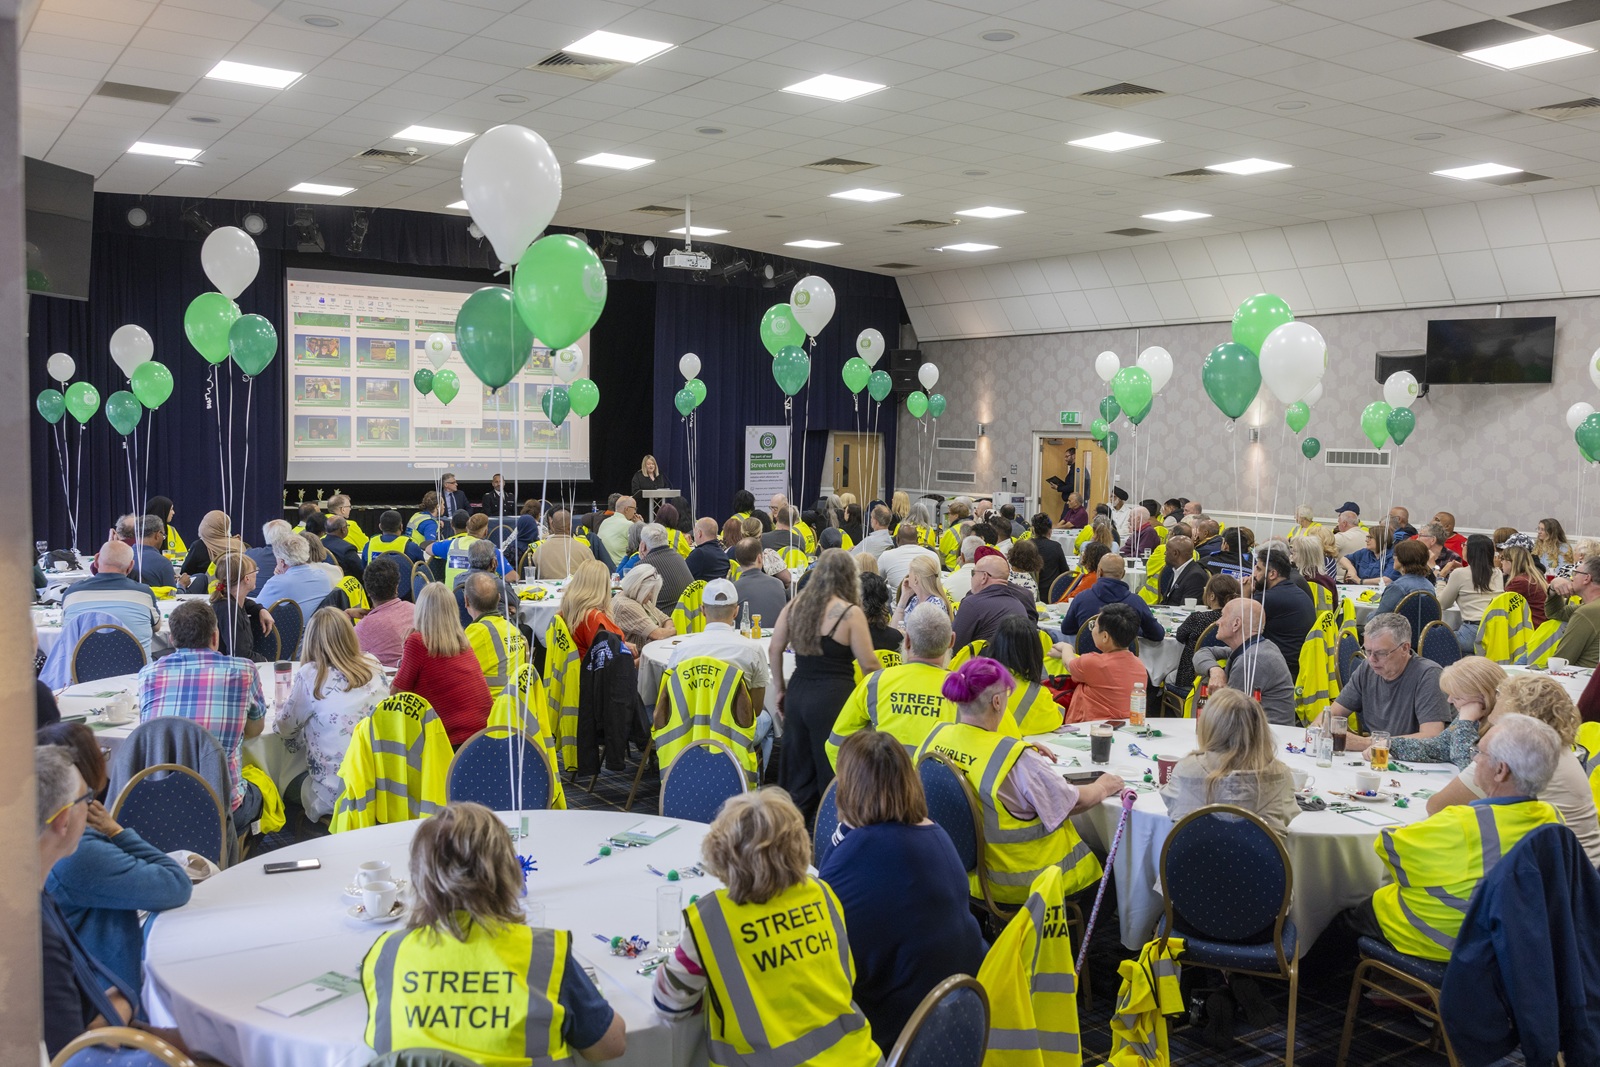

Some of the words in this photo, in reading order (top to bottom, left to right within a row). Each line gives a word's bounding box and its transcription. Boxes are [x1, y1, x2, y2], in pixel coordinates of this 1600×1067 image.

[890, 692, 945, 706] STREET
[891, 704, 940, 717] WATCH
[934, 745, 977, 766] SHIRLEY
[740, 901, 824, 944] STREET
[752, 930, 833, 973] WATCH
[402, 971, 518, 994] STREET
[405, 1005, 510, 1029] WATCH
